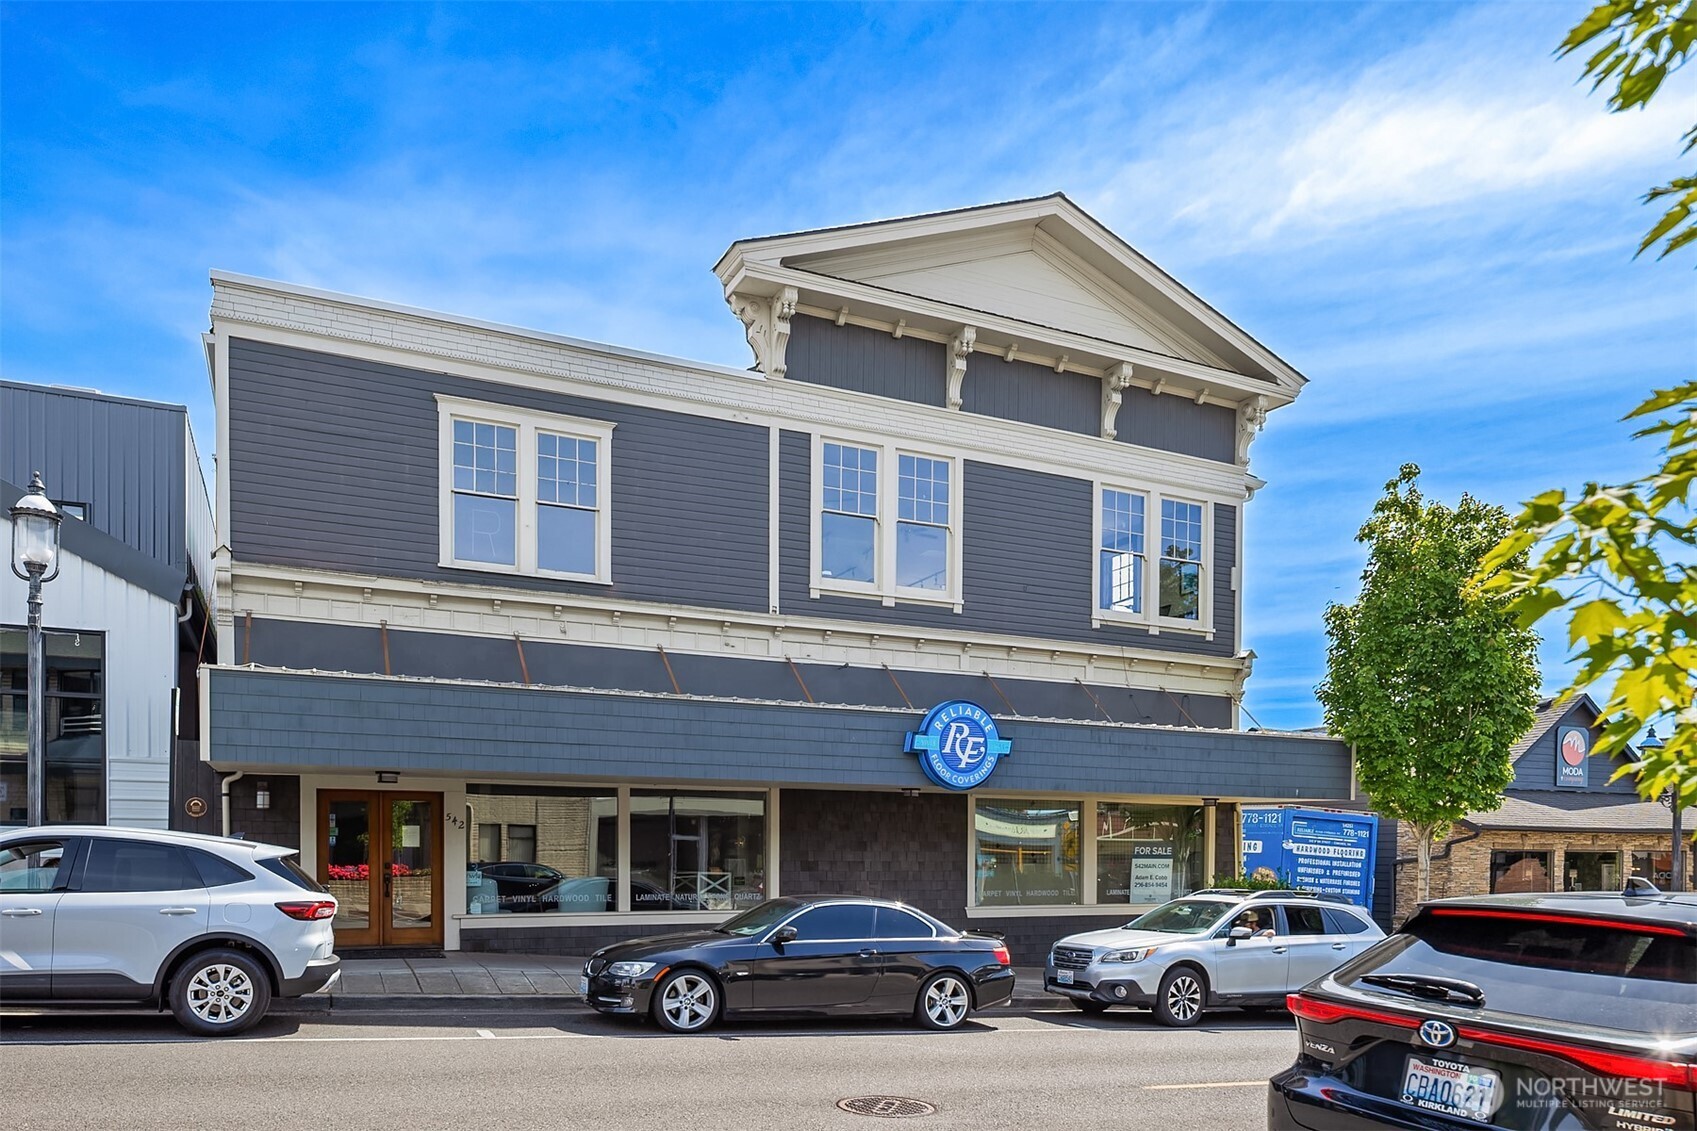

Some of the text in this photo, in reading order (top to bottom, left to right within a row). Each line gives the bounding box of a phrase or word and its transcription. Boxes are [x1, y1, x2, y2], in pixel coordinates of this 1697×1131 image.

[934, 706, 993, 733] RELIABLE
[931, 753, 994, 784] FLOOR COVERINGS
[1562, 767, 1583, 776] MODA
[446, 813, 465, 829] 542
[1242, 813, 1282, 824] 778-1121
[1343, 829, 1370, 838] 778-1121
[1134, 846, 1172, 855] FOR SALE
[1296, 845, 1364, 857] HARDWOOD FLOORING
[1298, 858, 1362, 868] PROFESSIONAL INSTALLATION
[473, 894, 612, 904] CARPET VINYL HARDWOOD TILE
[675, 893, 707, 901] NATUR
[1026, 889, 1059, 897] HARDWOOD
[1305, 1040, 1336, 1055] VENZA
[1413, 1063, 1462, 1079] WASHINGTON
[1432, 1059, 1470, 1073] TOYOTA
[1418, 1099, 1468, 1117] KIRKLAND
[1608, 1106, 1676, 1125] LIMITED
